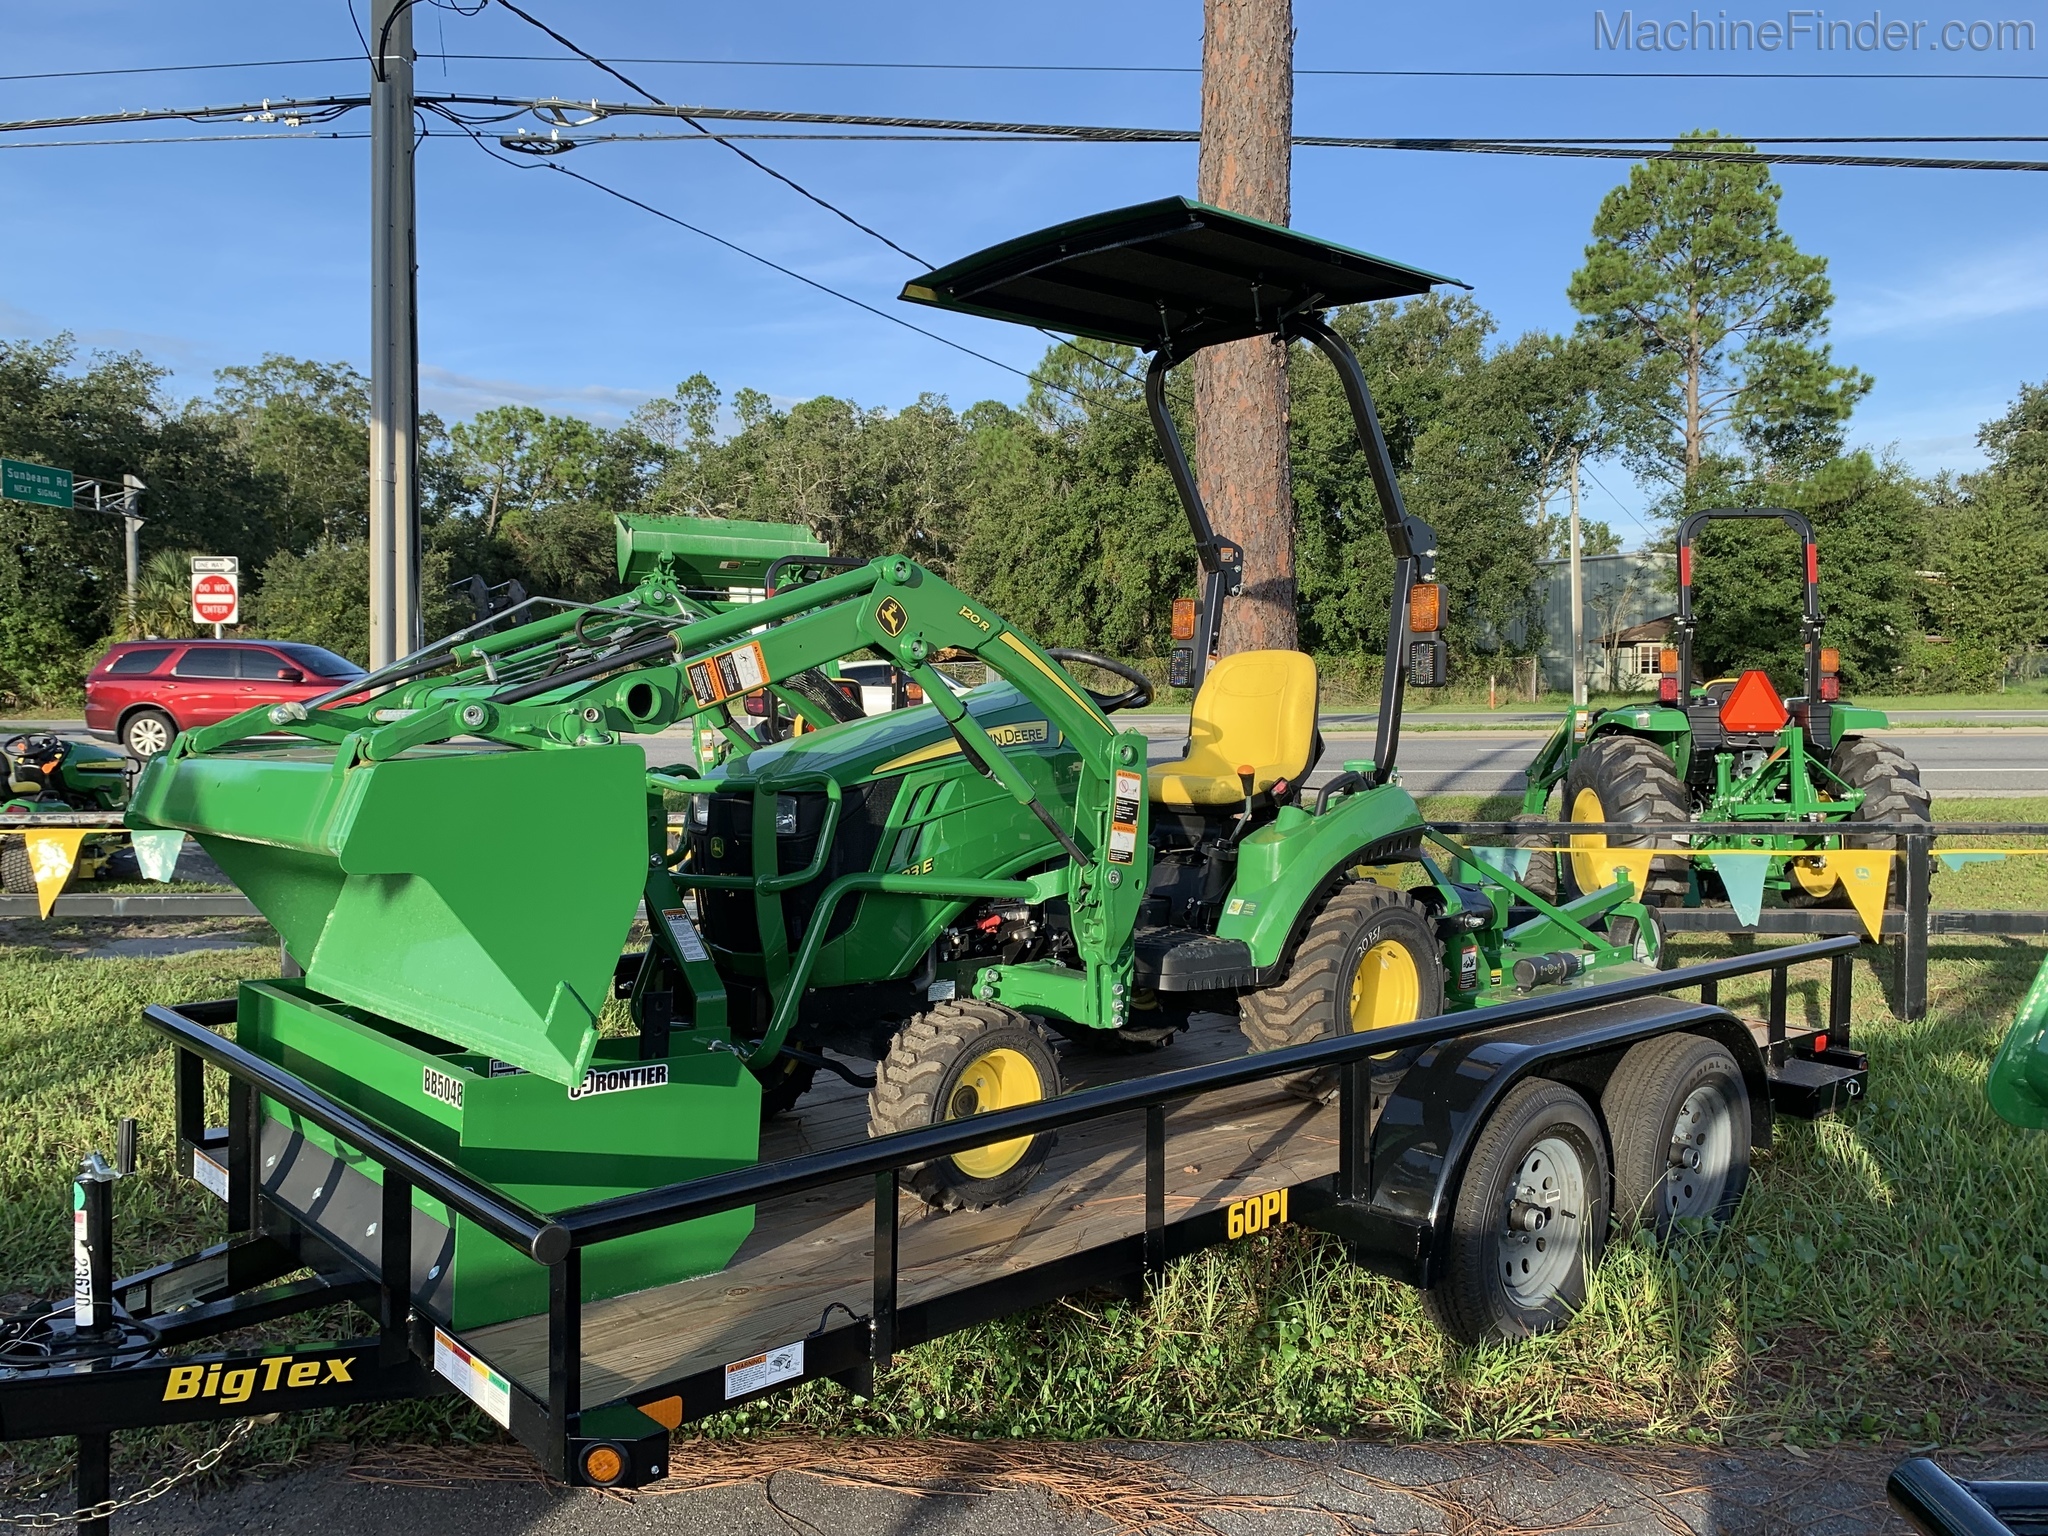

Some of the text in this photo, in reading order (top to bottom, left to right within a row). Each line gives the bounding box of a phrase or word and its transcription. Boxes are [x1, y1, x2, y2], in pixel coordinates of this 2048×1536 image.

[7, 467, 68, 488] Sunbeam Rd
[13, 484, 62, 500] NEXT SIGNAL
[196, 561, 224, 569] ONE WAY
[198, 583, 231, 593] DO NOT
[201, 604, 229, 614] ENTER
[1003, 728, 1044, 743] DEERE
[1357, 937, 1370, 958] 20
[423, 1067, 464, 1108] BB5048
[1227, 1187, 1289, 1240] 60PI
[162, 1356, 356, 1405] BigTex
